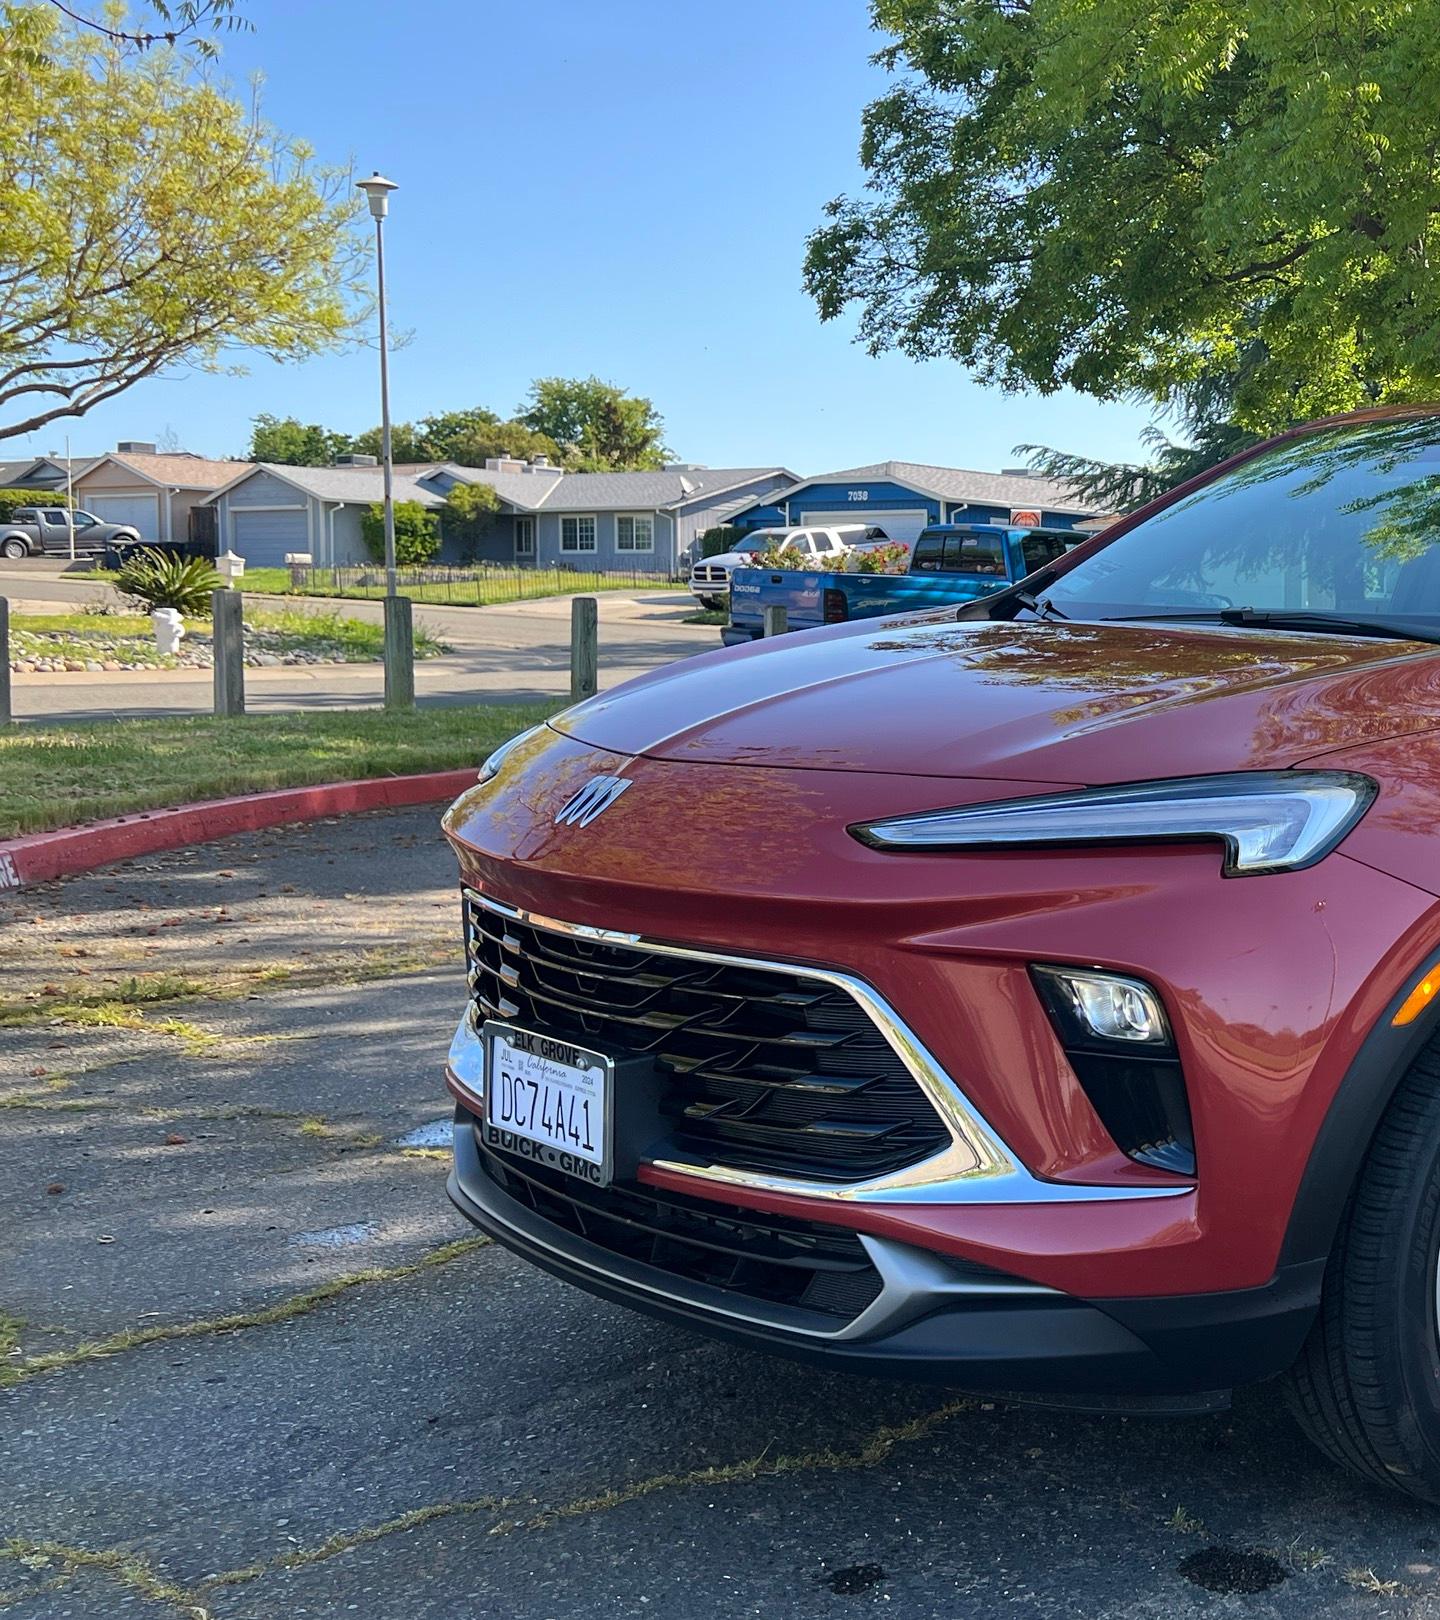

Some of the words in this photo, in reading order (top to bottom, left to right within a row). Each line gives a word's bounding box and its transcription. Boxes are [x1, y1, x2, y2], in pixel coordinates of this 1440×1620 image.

[847, 490, 869, 501] 7038
[734, 585, 760, 593] DODGE
[501, 1048, 512, 1063] JUL
[514, 1031, 535, 1052] ELK
[541, 1039, 580, 1066] GROVE
[527, 1054, 566, 1079] California
[582, 1075, 593, 1085] 2024
[501, 1072, 594, 1151] DC74A41
[488, 1127, 544, 1161] BUICK
[559, 1152, 601, 1182] GMC
